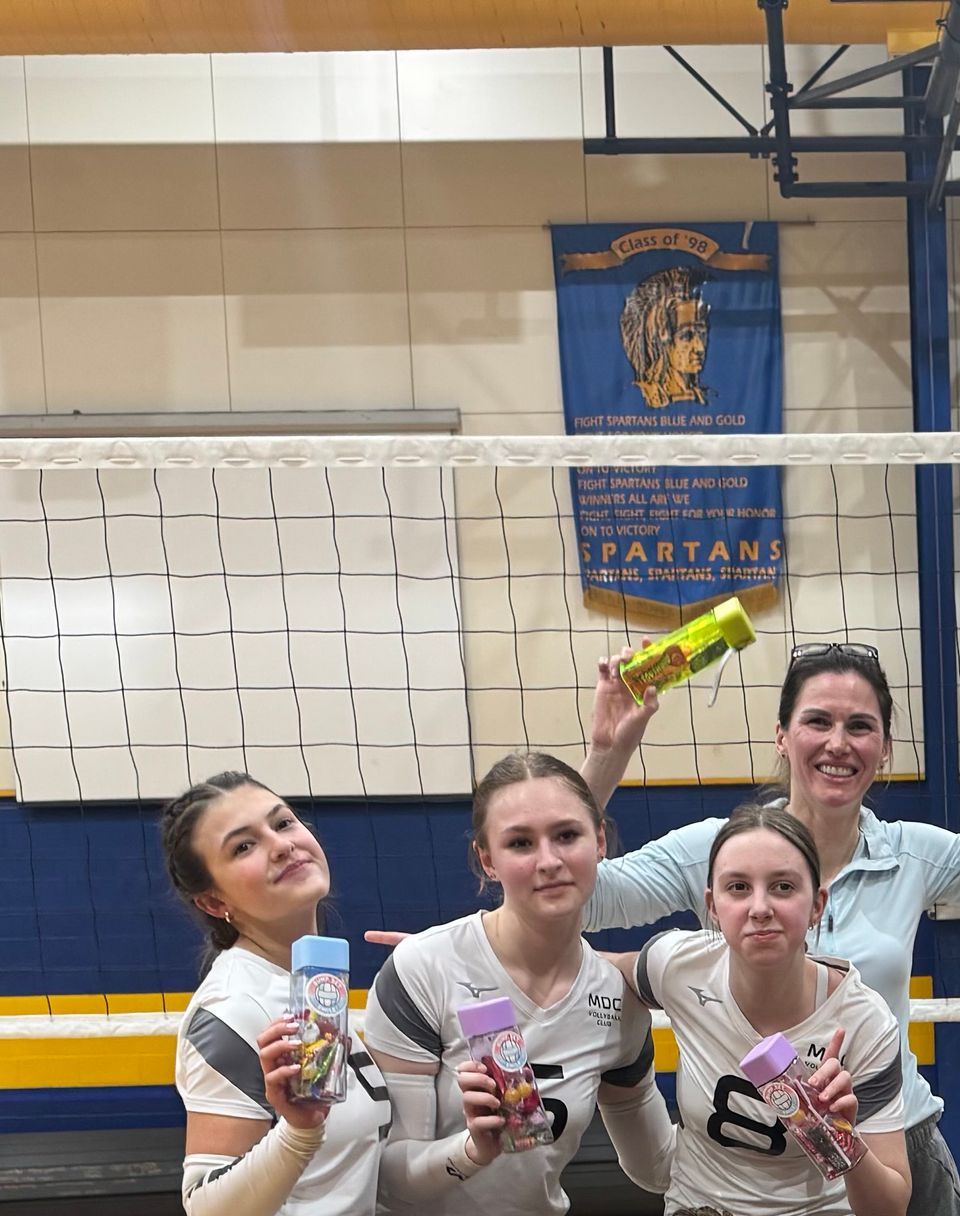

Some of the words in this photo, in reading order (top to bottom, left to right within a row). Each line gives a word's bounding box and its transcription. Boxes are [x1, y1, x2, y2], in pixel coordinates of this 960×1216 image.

[618, 236, 658, 255] Class
[662, 232, 679, 246] of
[684, 234, 709, 254] '98
[574, 415, 604, 429] FIGHT
[606, 415, 658, 427] SPARTANS
[660, 415, 687, 427] BLUE
[689, 415, 713, 427] AND
[715, 414, 746, 426] GOLD
[577, 479, 606, 490] FIGHT
[609, 478, 661, 489] SPARTANS
[664, 478, 689, 489] BLUE
[692, 477, 716, 489] AND
[718, 476, 748, 488] GOLD
[578, 494, 626, 505] WINNERS
[628, 493, 648, 504] ALL
[649, 493, 668, 504] ARE
[672, 493, 690, 504] WE
[736, 508, 776, 518] HONOR
[580, 525, 598, 537] ON
[600, 525, 614, 536] TO
[616, 524, 661, 536] VICTORY
[581, 539, 782, 563] SPARTANS
[588, 992, 622, 1011] MDC
[707, 1074, 788, 1156] 8
